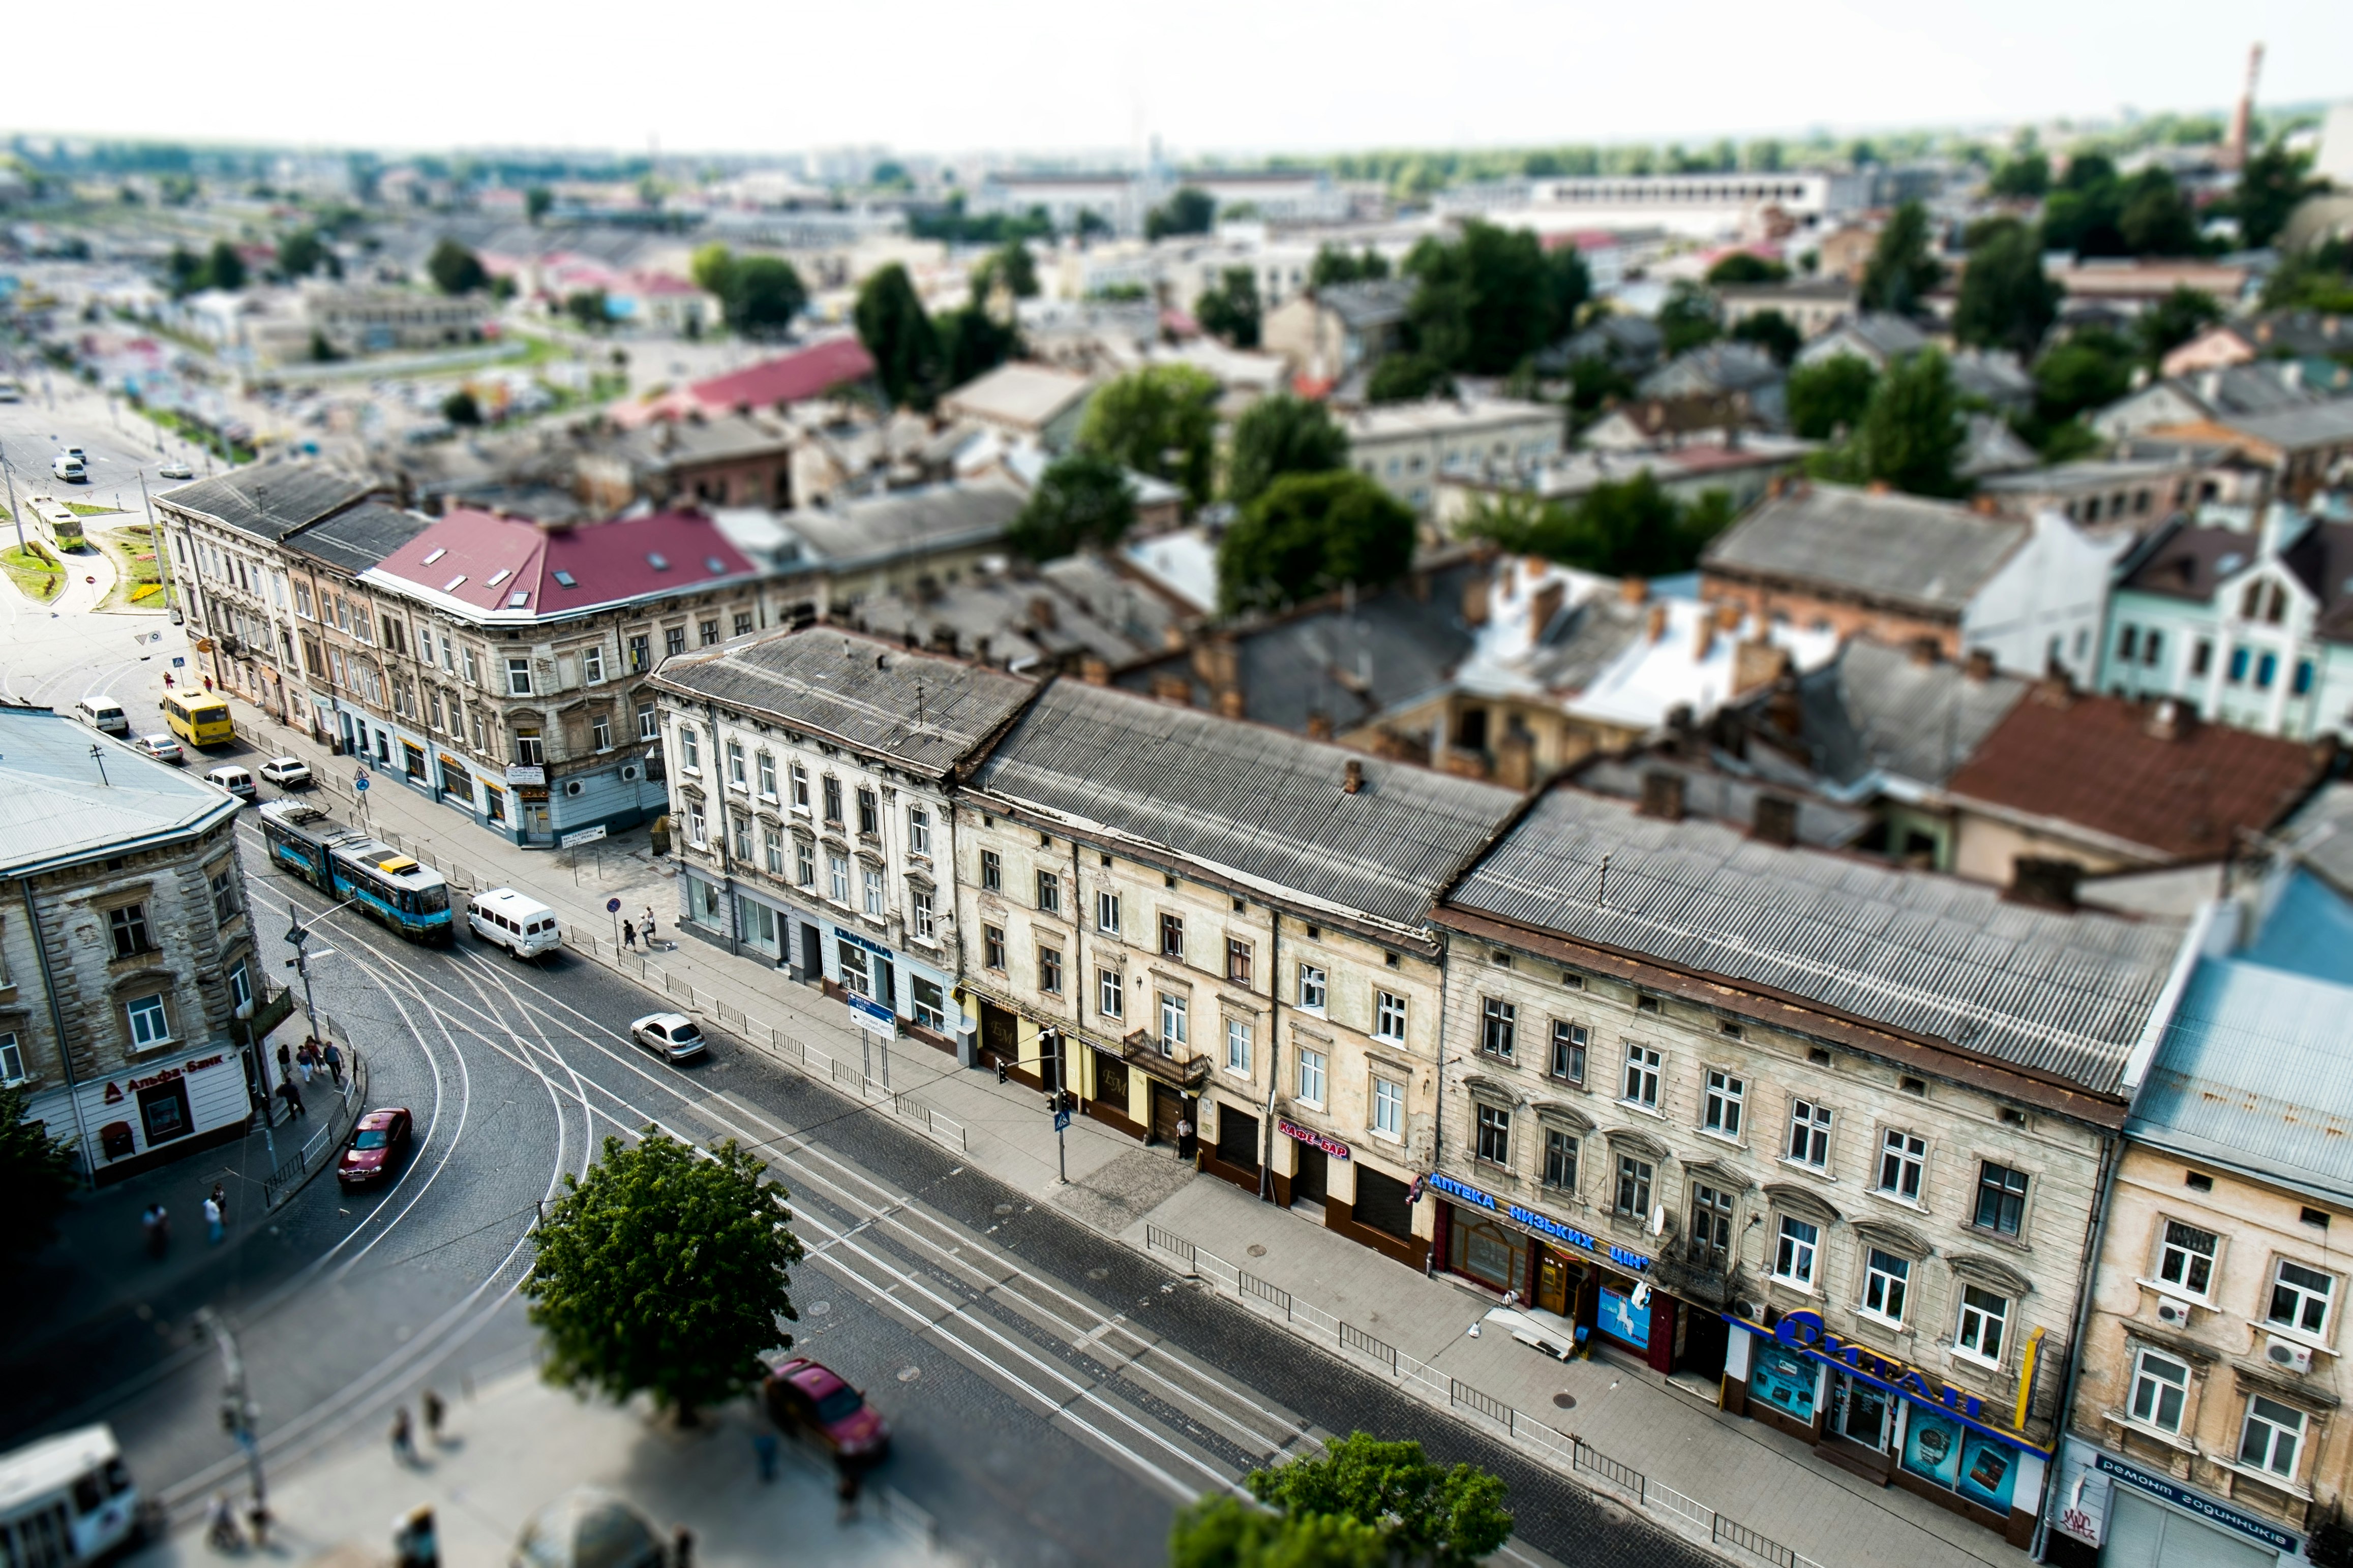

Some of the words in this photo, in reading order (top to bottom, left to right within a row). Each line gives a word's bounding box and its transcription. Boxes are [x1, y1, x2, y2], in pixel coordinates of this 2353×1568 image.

[1429, 1173, 1496, 1210] АПТЕКА
[1509, 1205, 1595, 1251] НИЗЬКИХ
[2182, 1494, 2287, 1545] годинників
